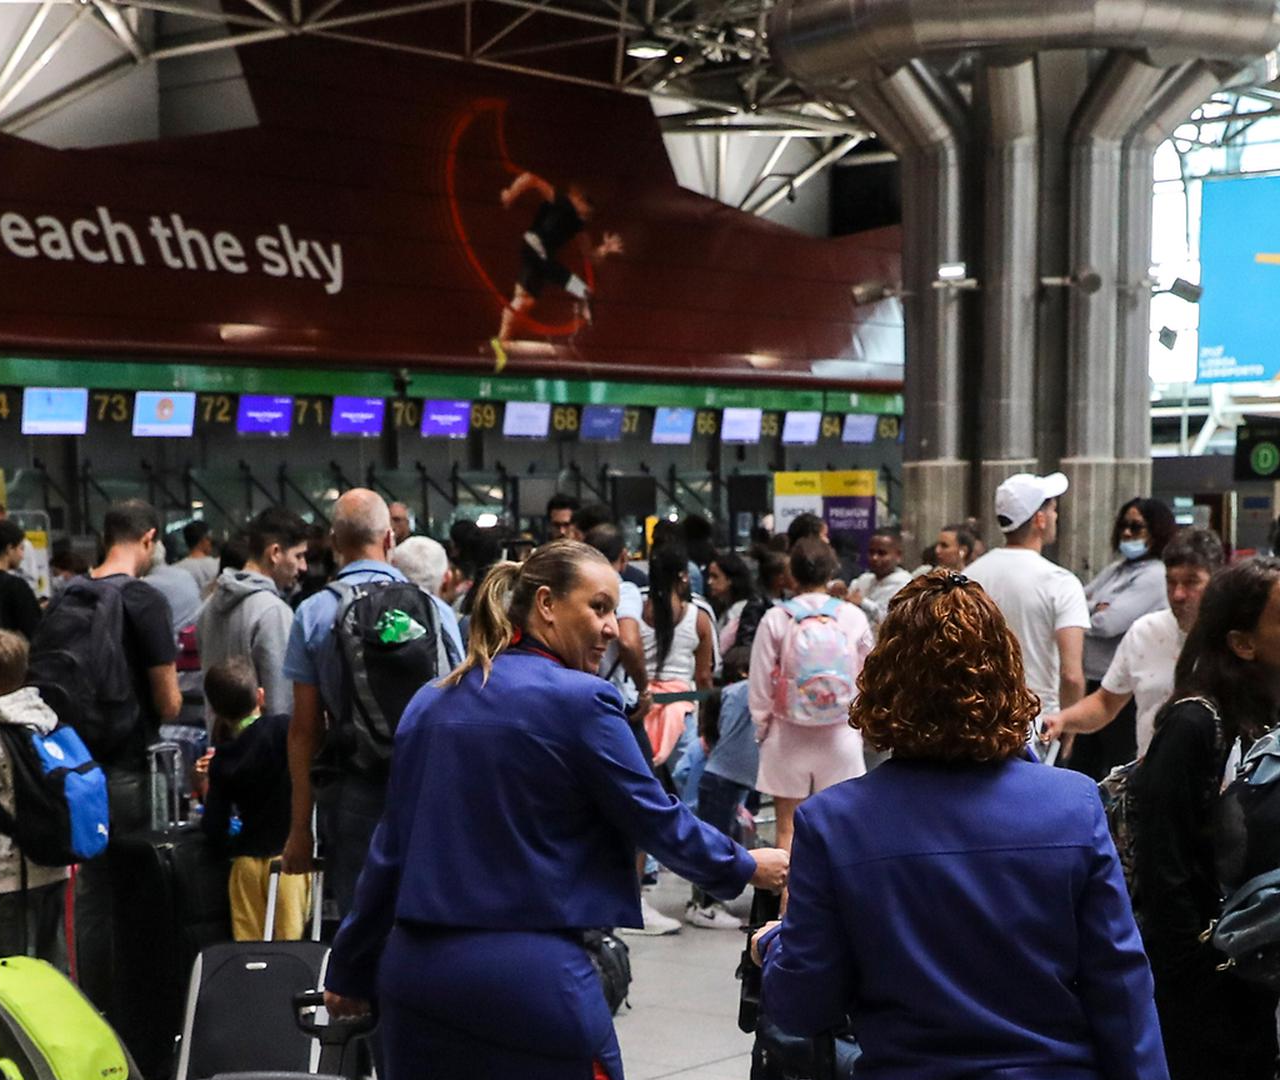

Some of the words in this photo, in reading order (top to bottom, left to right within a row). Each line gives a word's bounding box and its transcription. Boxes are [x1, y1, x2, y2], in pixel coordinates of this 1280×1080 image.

[150, 213, 249, 274] the
[255, 224, 343, 295] sky
[94, 393, 128, 422] 73
[199, 395, 231, 424] 72
[297, 399, 323, 425] 71
[393, 403, 417, 427] 70
[470, 405, 497, 429] 69
[553, 407, 578, 431] 68
